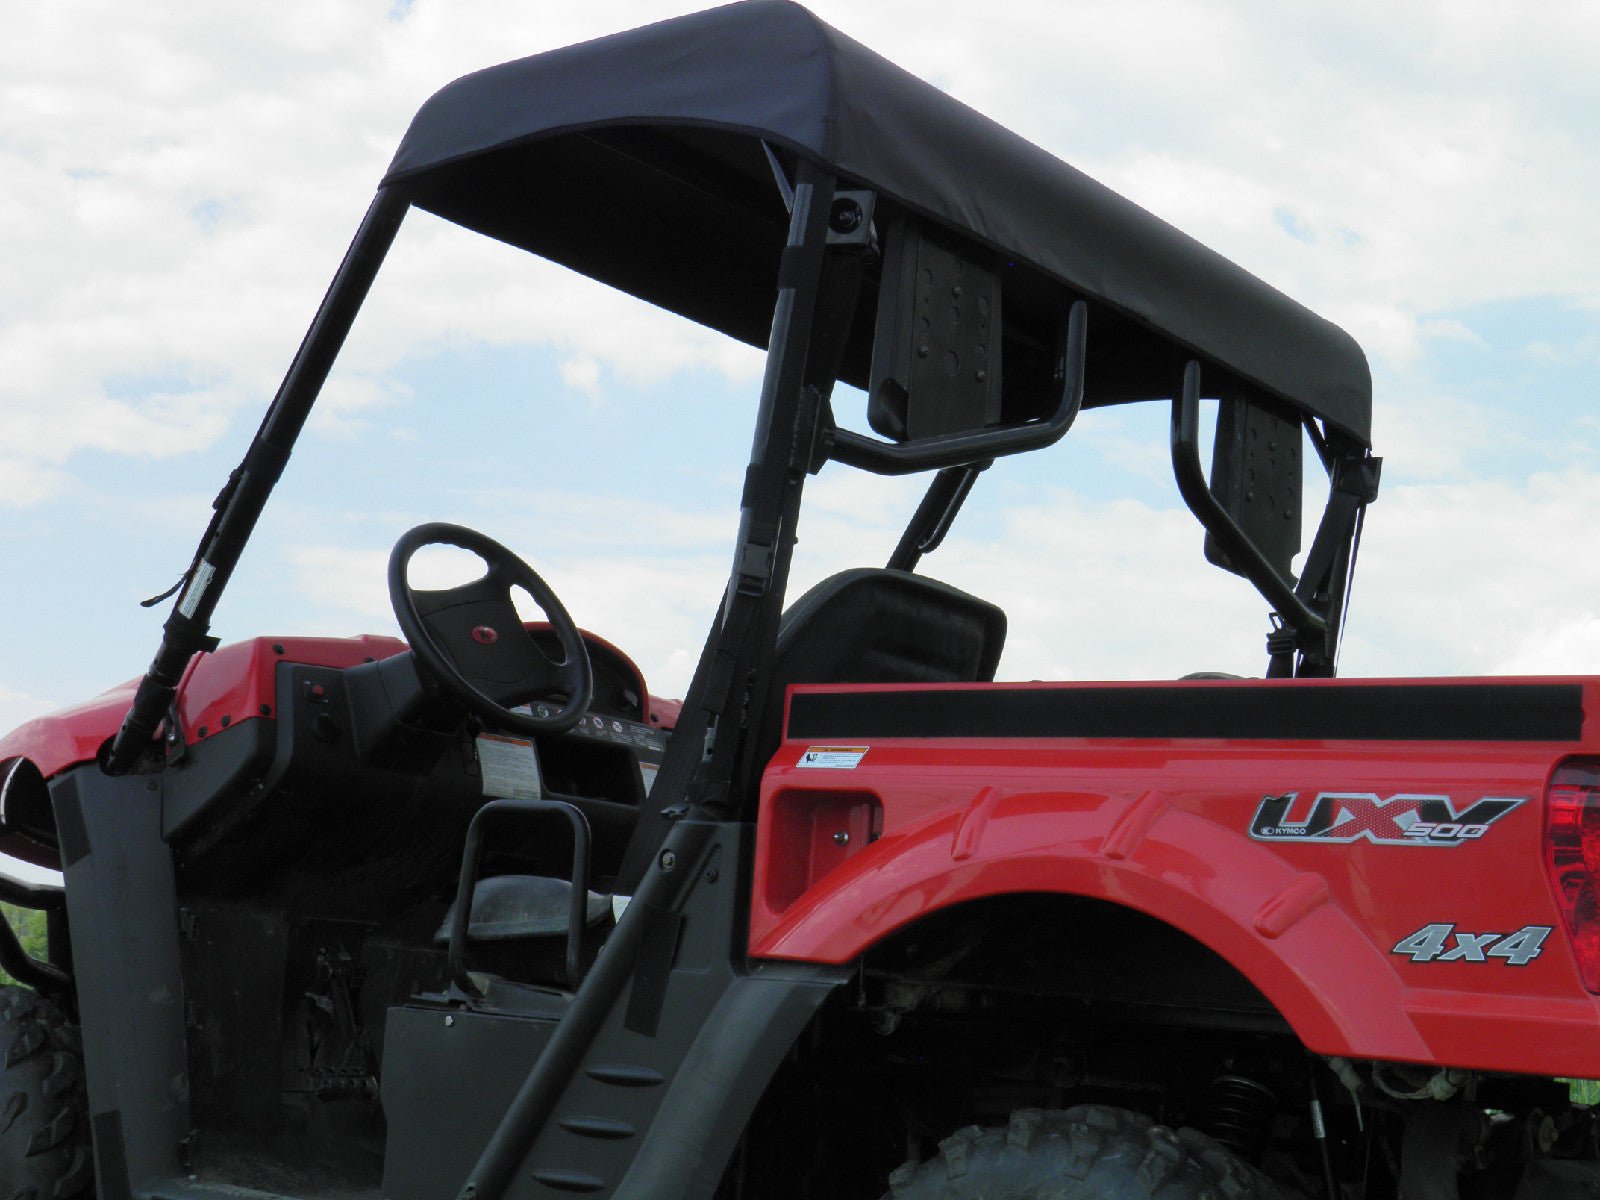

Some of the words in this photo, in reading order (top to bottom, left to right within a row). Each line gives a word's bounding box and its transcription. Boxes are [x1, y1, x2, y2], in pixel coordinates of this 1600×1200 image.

[1249, 792, 1528, 846] UXV
[1275, 827, 1307, 836] KYMCO
[1403, 822, 1490, 839] 500
